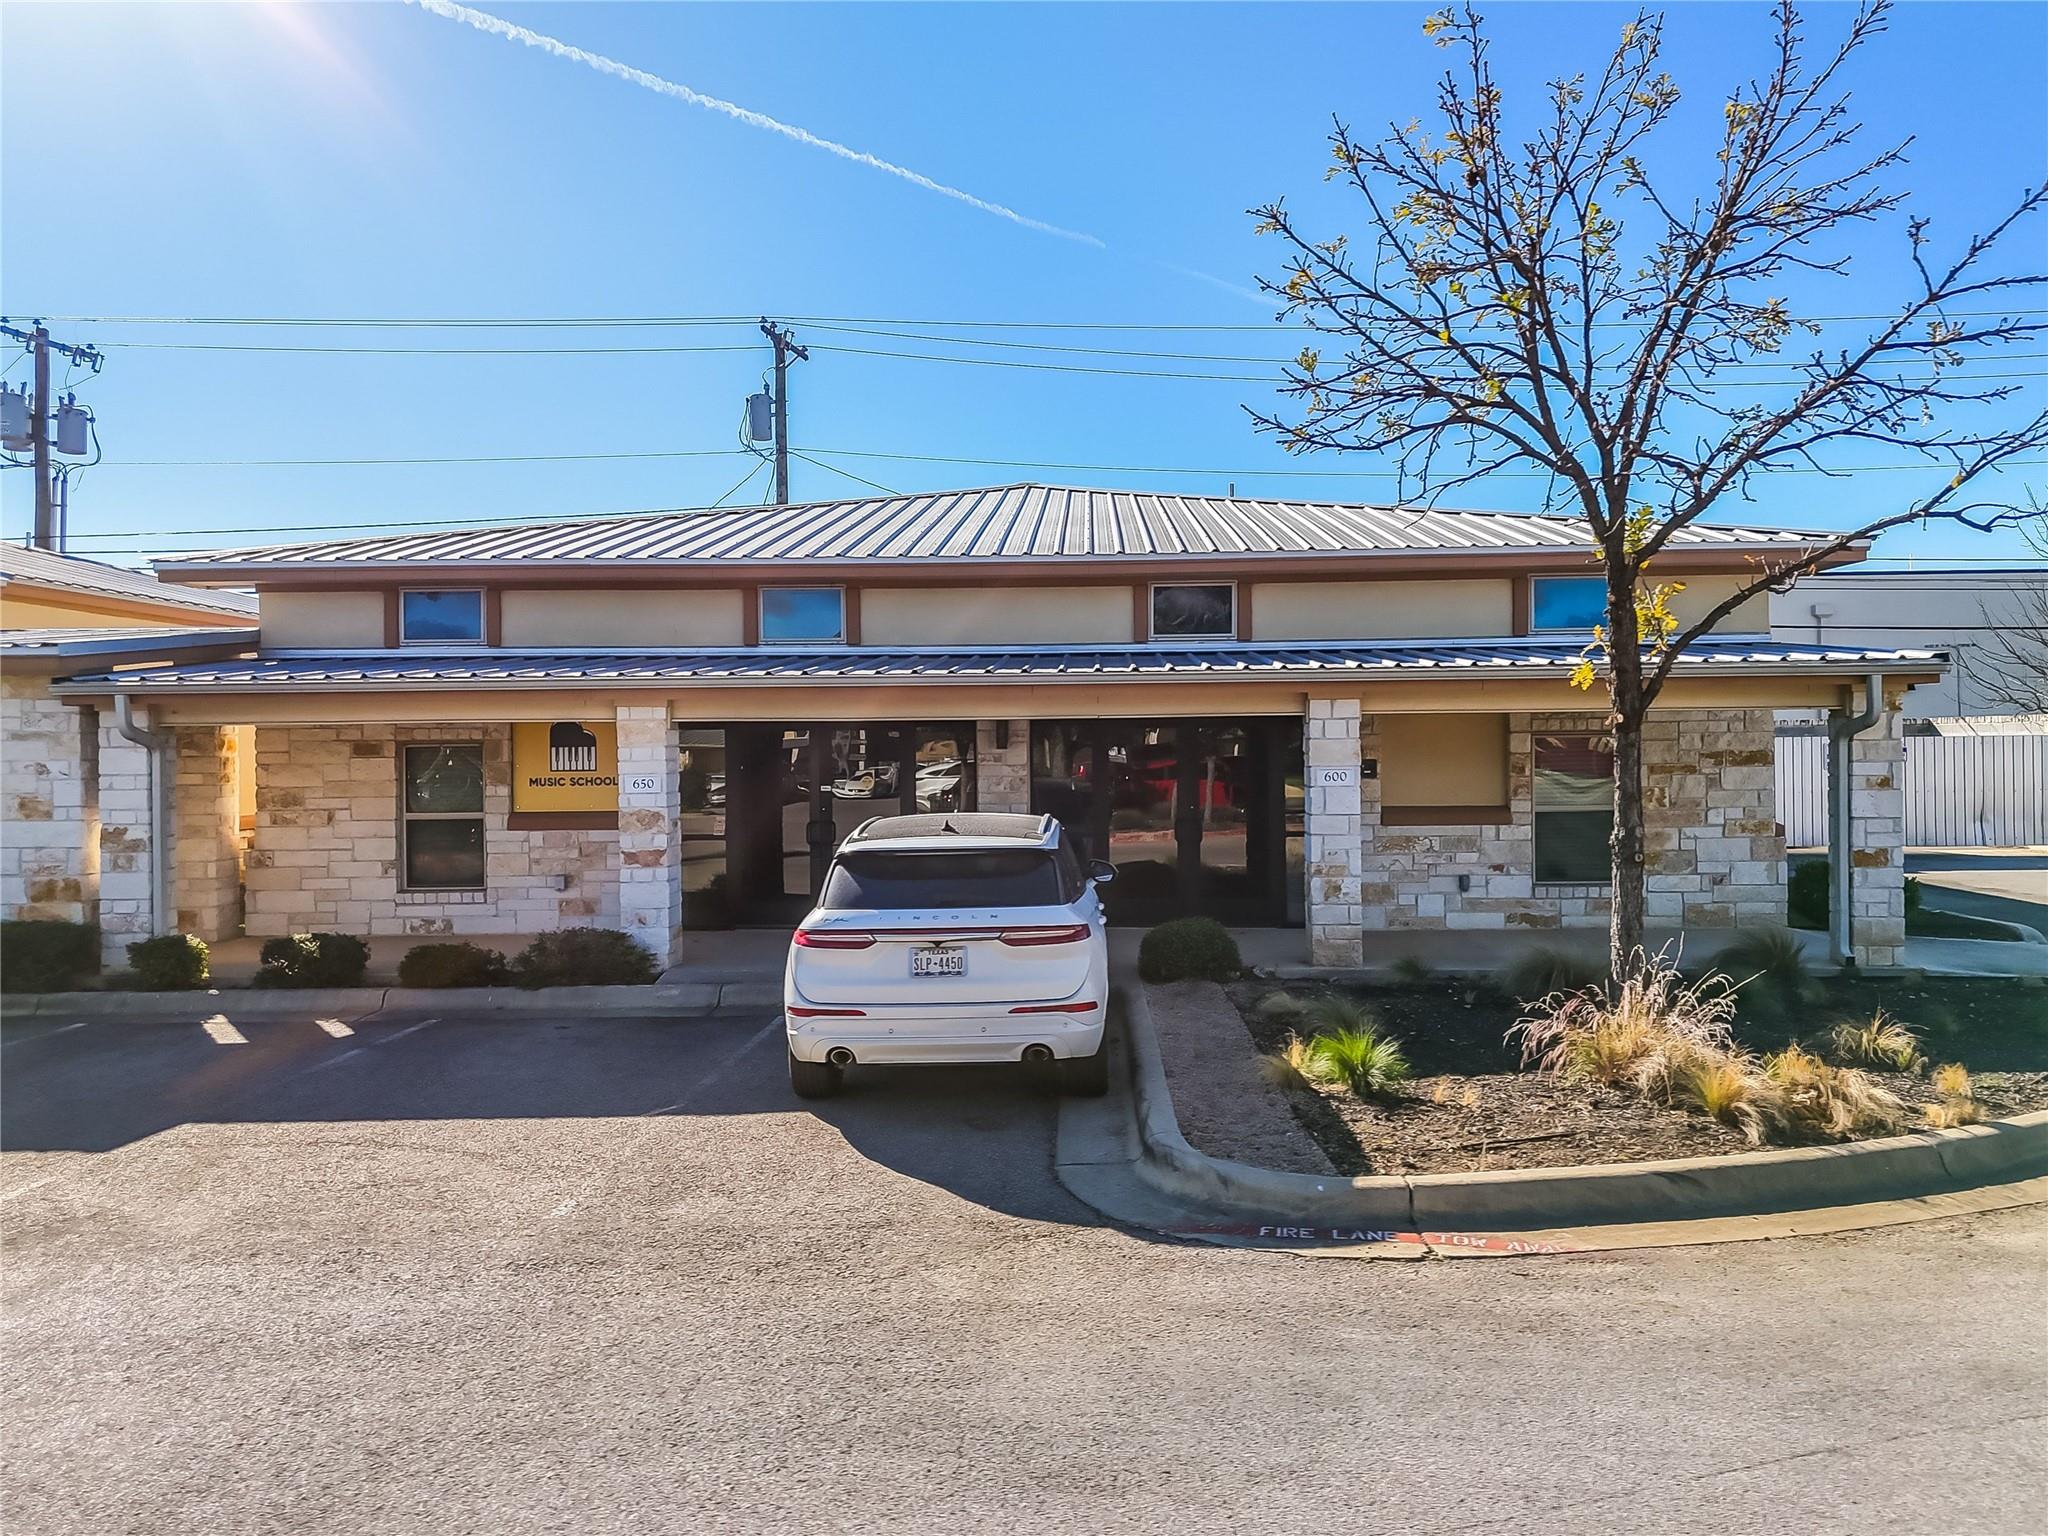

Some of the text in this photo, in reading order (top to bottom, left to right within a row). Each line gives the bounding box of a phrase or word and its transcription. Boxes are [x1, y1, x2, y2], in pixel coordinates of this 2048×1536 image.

[529, 776, 618, 787] MUSIC SCHOOL
[1324, 771, 1347, 782] 600
[632, 778, 655, 790] 650
[1259, 1226, 1315, 1239] FIRE
[1332, 1229, 1400, 1242] LANE
